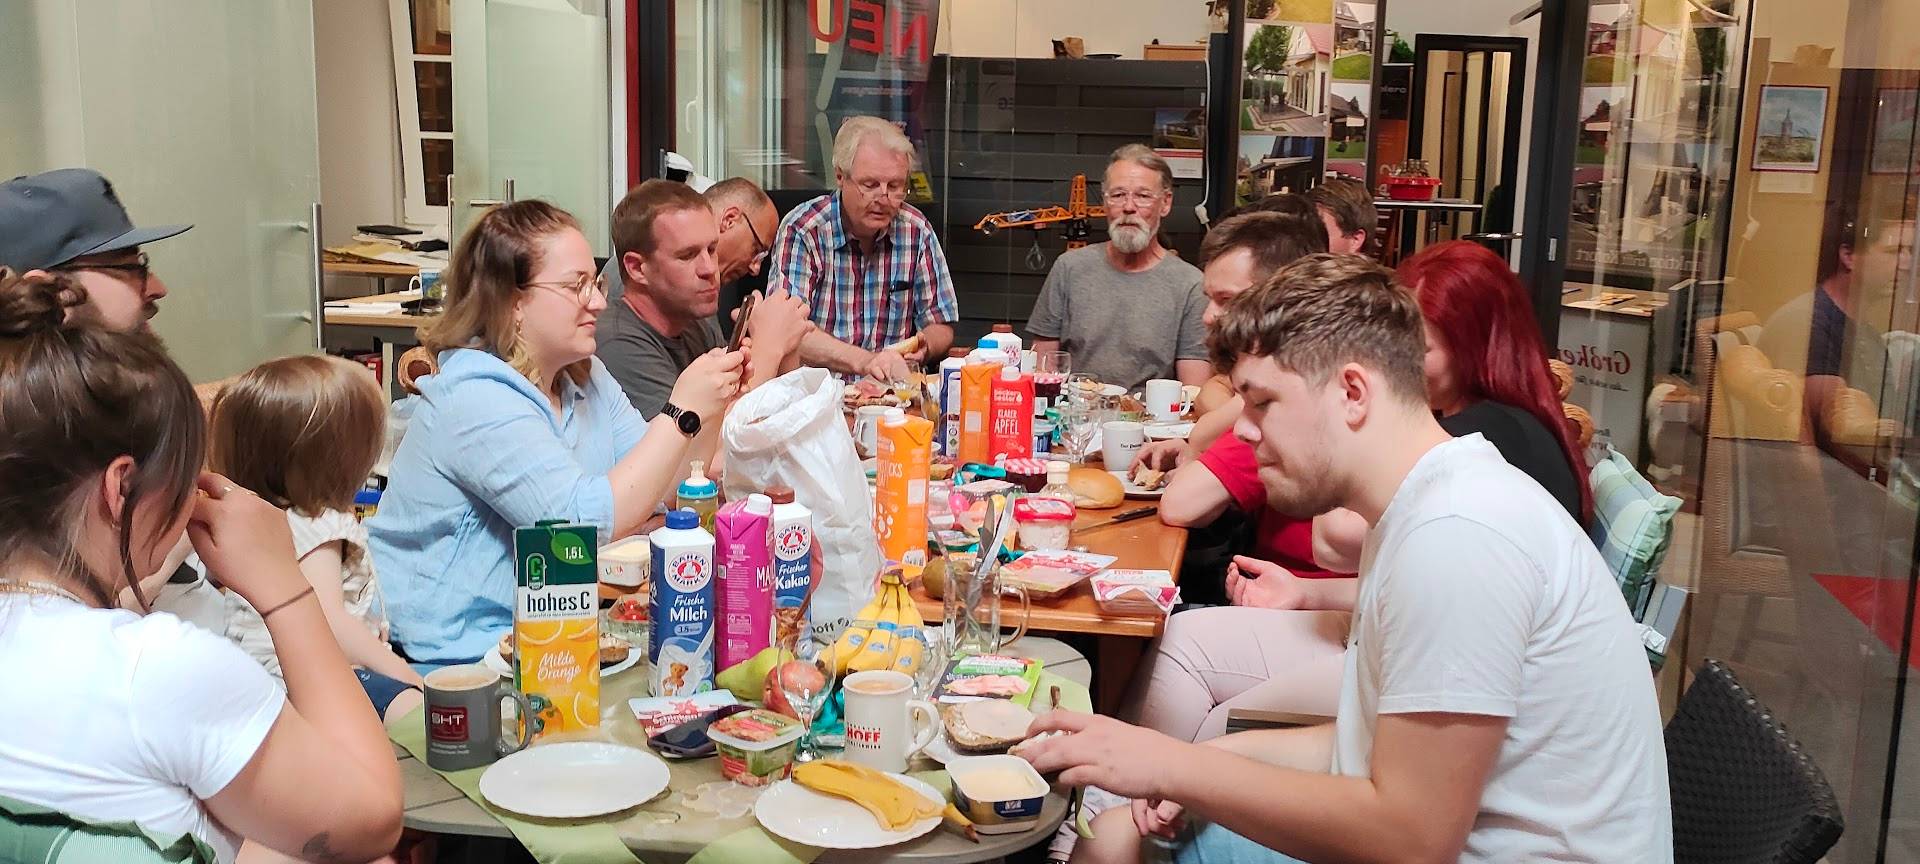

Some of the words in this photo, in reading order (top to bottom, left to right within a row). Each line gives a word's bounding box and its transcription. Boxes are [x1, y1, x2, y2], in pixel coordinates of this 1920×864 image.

[994, 419, 1020, 435] APFEL
[775, 575, 811, 590] Kakao
[527, 593, 577, 612] hohes
[581, 591, 590, 609] C
[674, 593, 705, 607] Frische
[670, 605, 708, 622] Milch
[539, 650, 575, 668] Milde
[537, 664, 582, 683] Orange
[847, 725, 881, 743] HOFF
